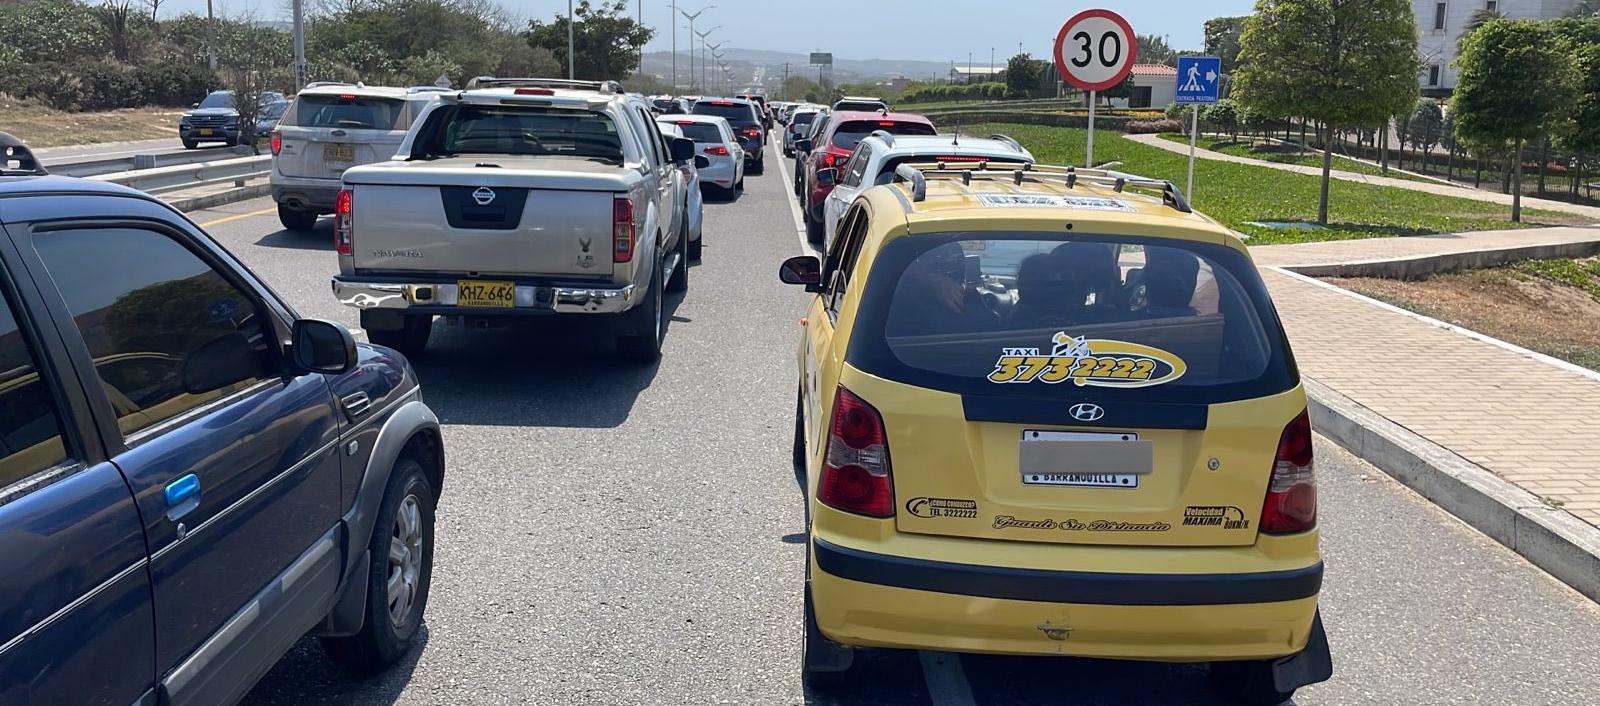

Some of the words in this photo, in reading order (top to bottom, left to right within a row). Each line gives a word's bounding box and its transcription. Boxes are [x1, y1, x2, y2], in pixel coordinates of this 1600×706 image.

[1071, 31, 1121, 67] 30
[1005, 348, 1039, 356] TAXI
[929, 508, 943, 516] TEL.
[944, 508, 978, 518] 3222222
[1186, 506, 1223, 515] Velocidad
[1060, 519, 1086, 530] Su
[1087, 520, 1171, 531] Distancia
[1183, 516, 1223, 526] MAXIMA
